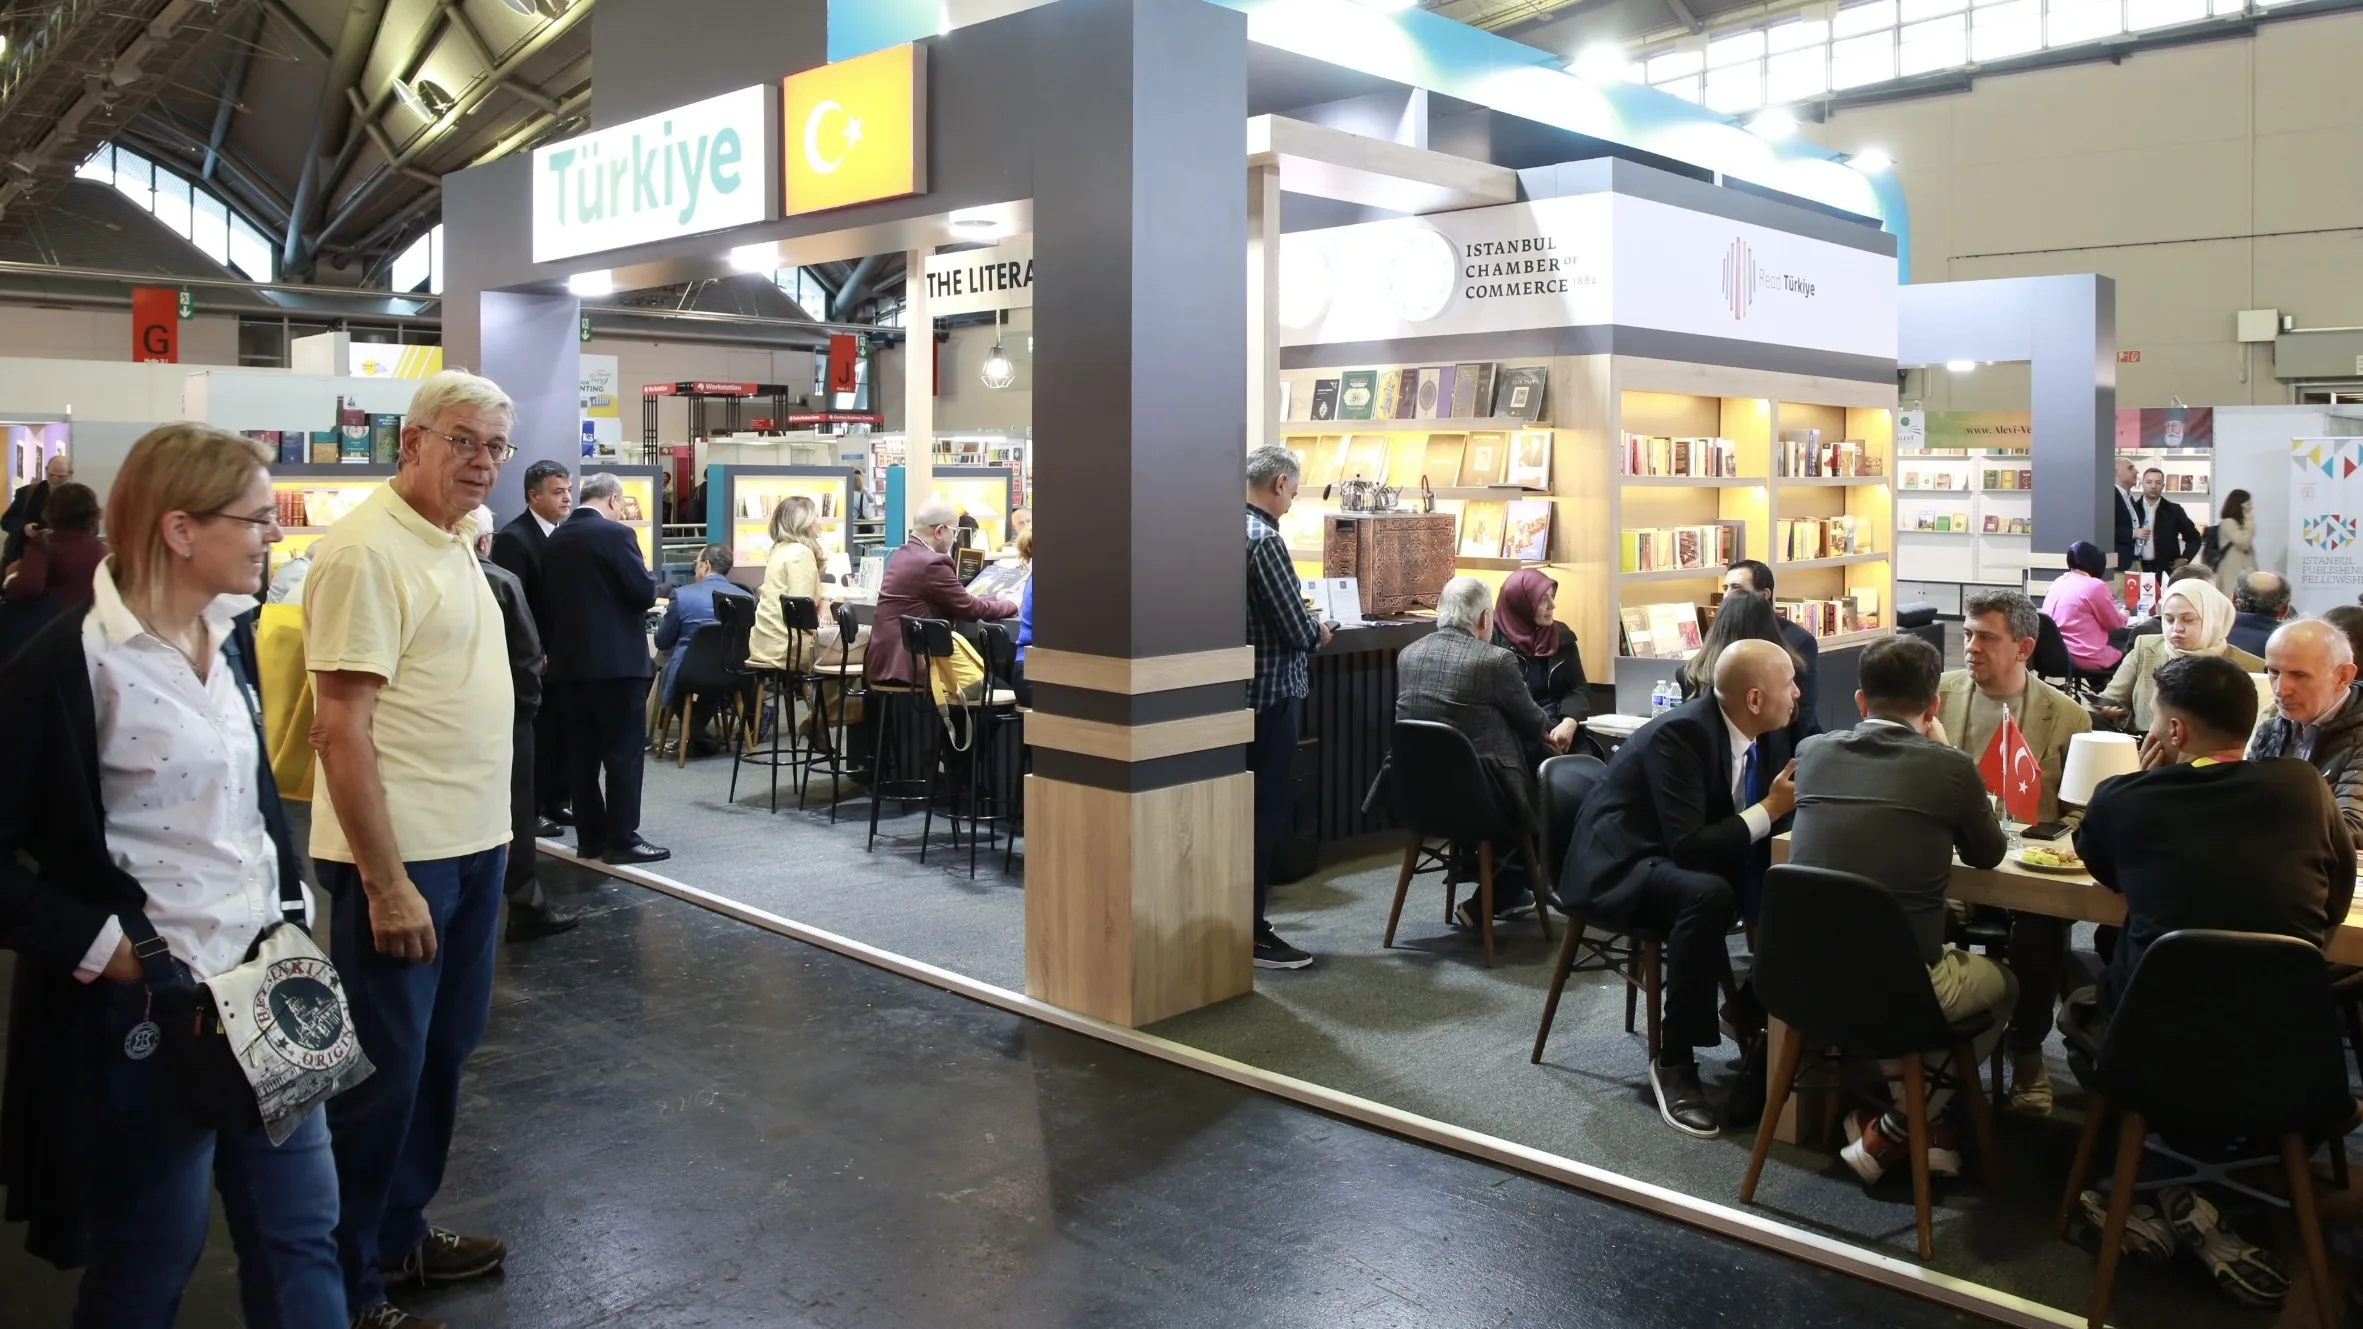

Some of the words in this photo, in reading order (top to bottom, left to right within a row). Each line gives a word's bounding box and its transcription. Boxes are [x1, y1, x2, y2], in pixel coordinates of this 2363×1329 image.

[549, 120, 742, 227] Türkiye
[1466, 236, 1557, 257] ISTANBUL
[1465, 258, 1561, 278] CHAMBER
[1563, 256, 1578, 265] OF
[926, 269, 962, 299] THE
[969, 259, 1034, 294] LITERA
[1465, 279, 1568, 299] COMMERCE
[1572, 276, 1597, 287] 1882
[1759, 268, 1781, 290] Read
[1783, 274, 1816, 299] Türkiye
[143, 324, 169, 355] G
[838, 361, 850, 384] J
[705, 383, 742, 392] Workstation
